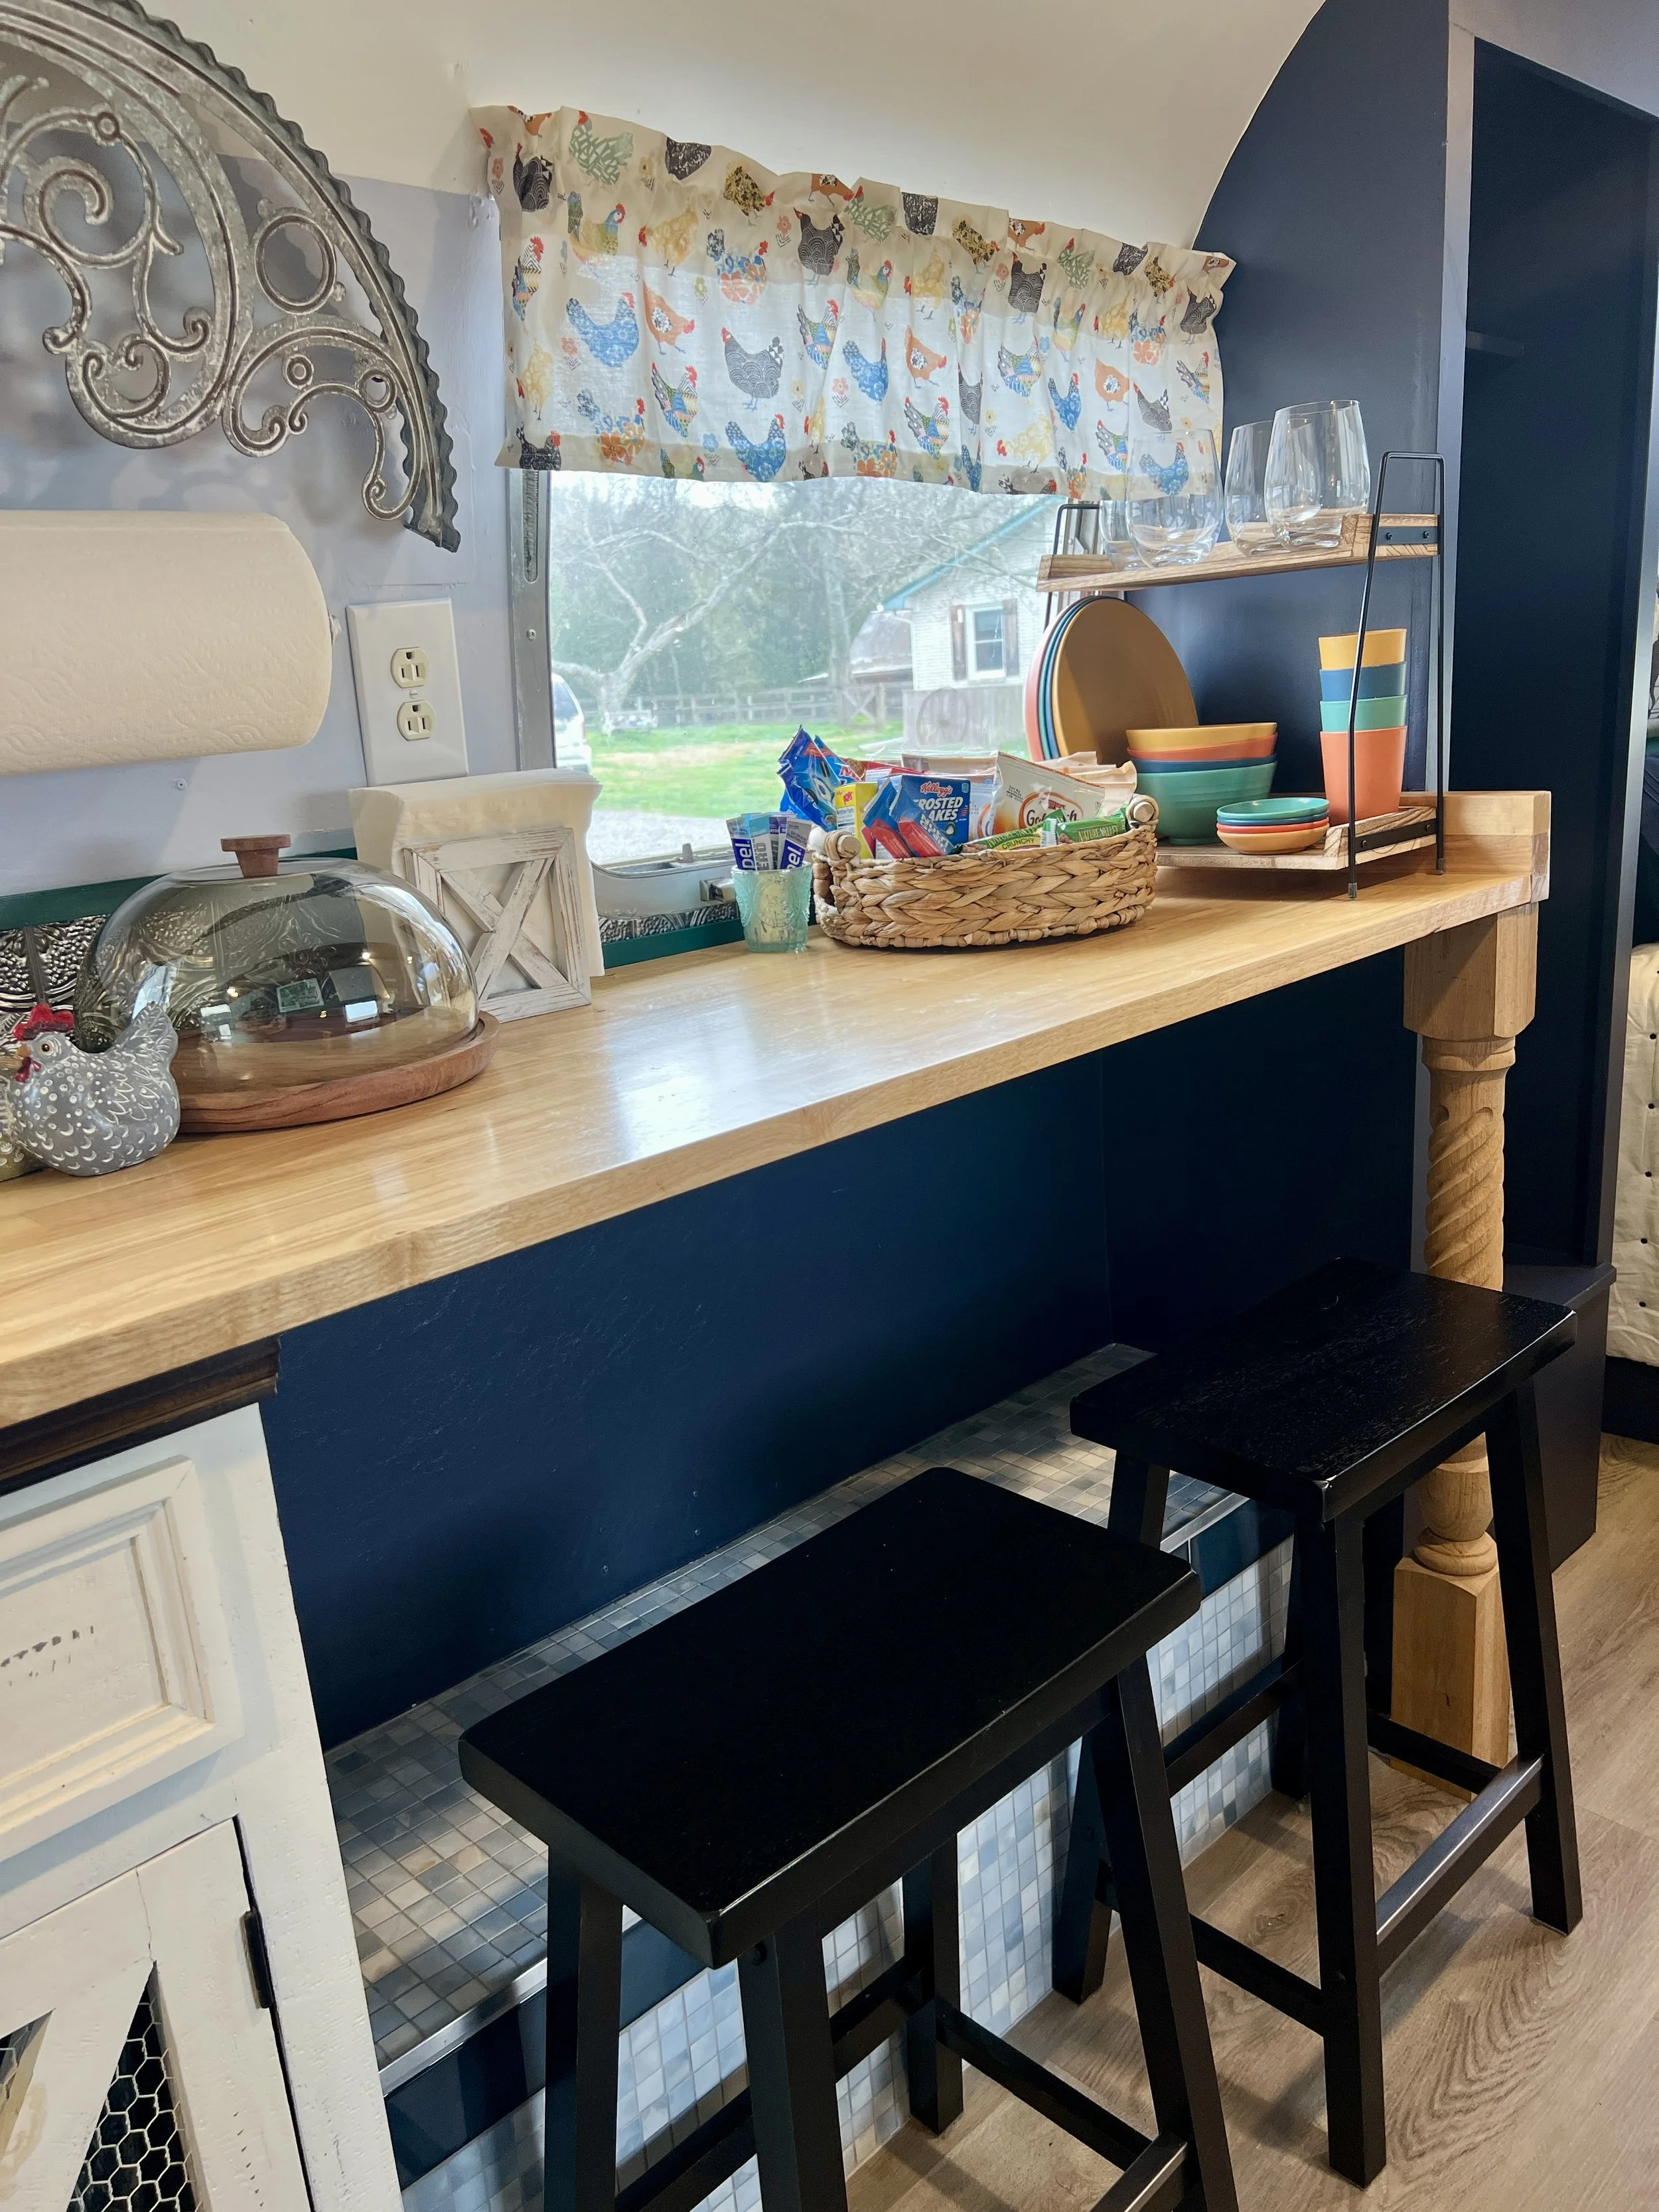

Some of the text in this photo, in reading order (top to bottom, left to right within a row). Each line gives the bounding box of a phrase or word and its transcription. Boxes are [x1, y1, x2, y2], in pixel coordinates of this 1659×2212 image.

[920, 781, 953, 797] Kellogg's
[913, 797, 964, 810] ROSTED
[928, 809, 958, 822] AKES
[1078, 825, 1118, 842] NATURE VALLEY
[1002, 837, 1035, 850] CRUNCHY
